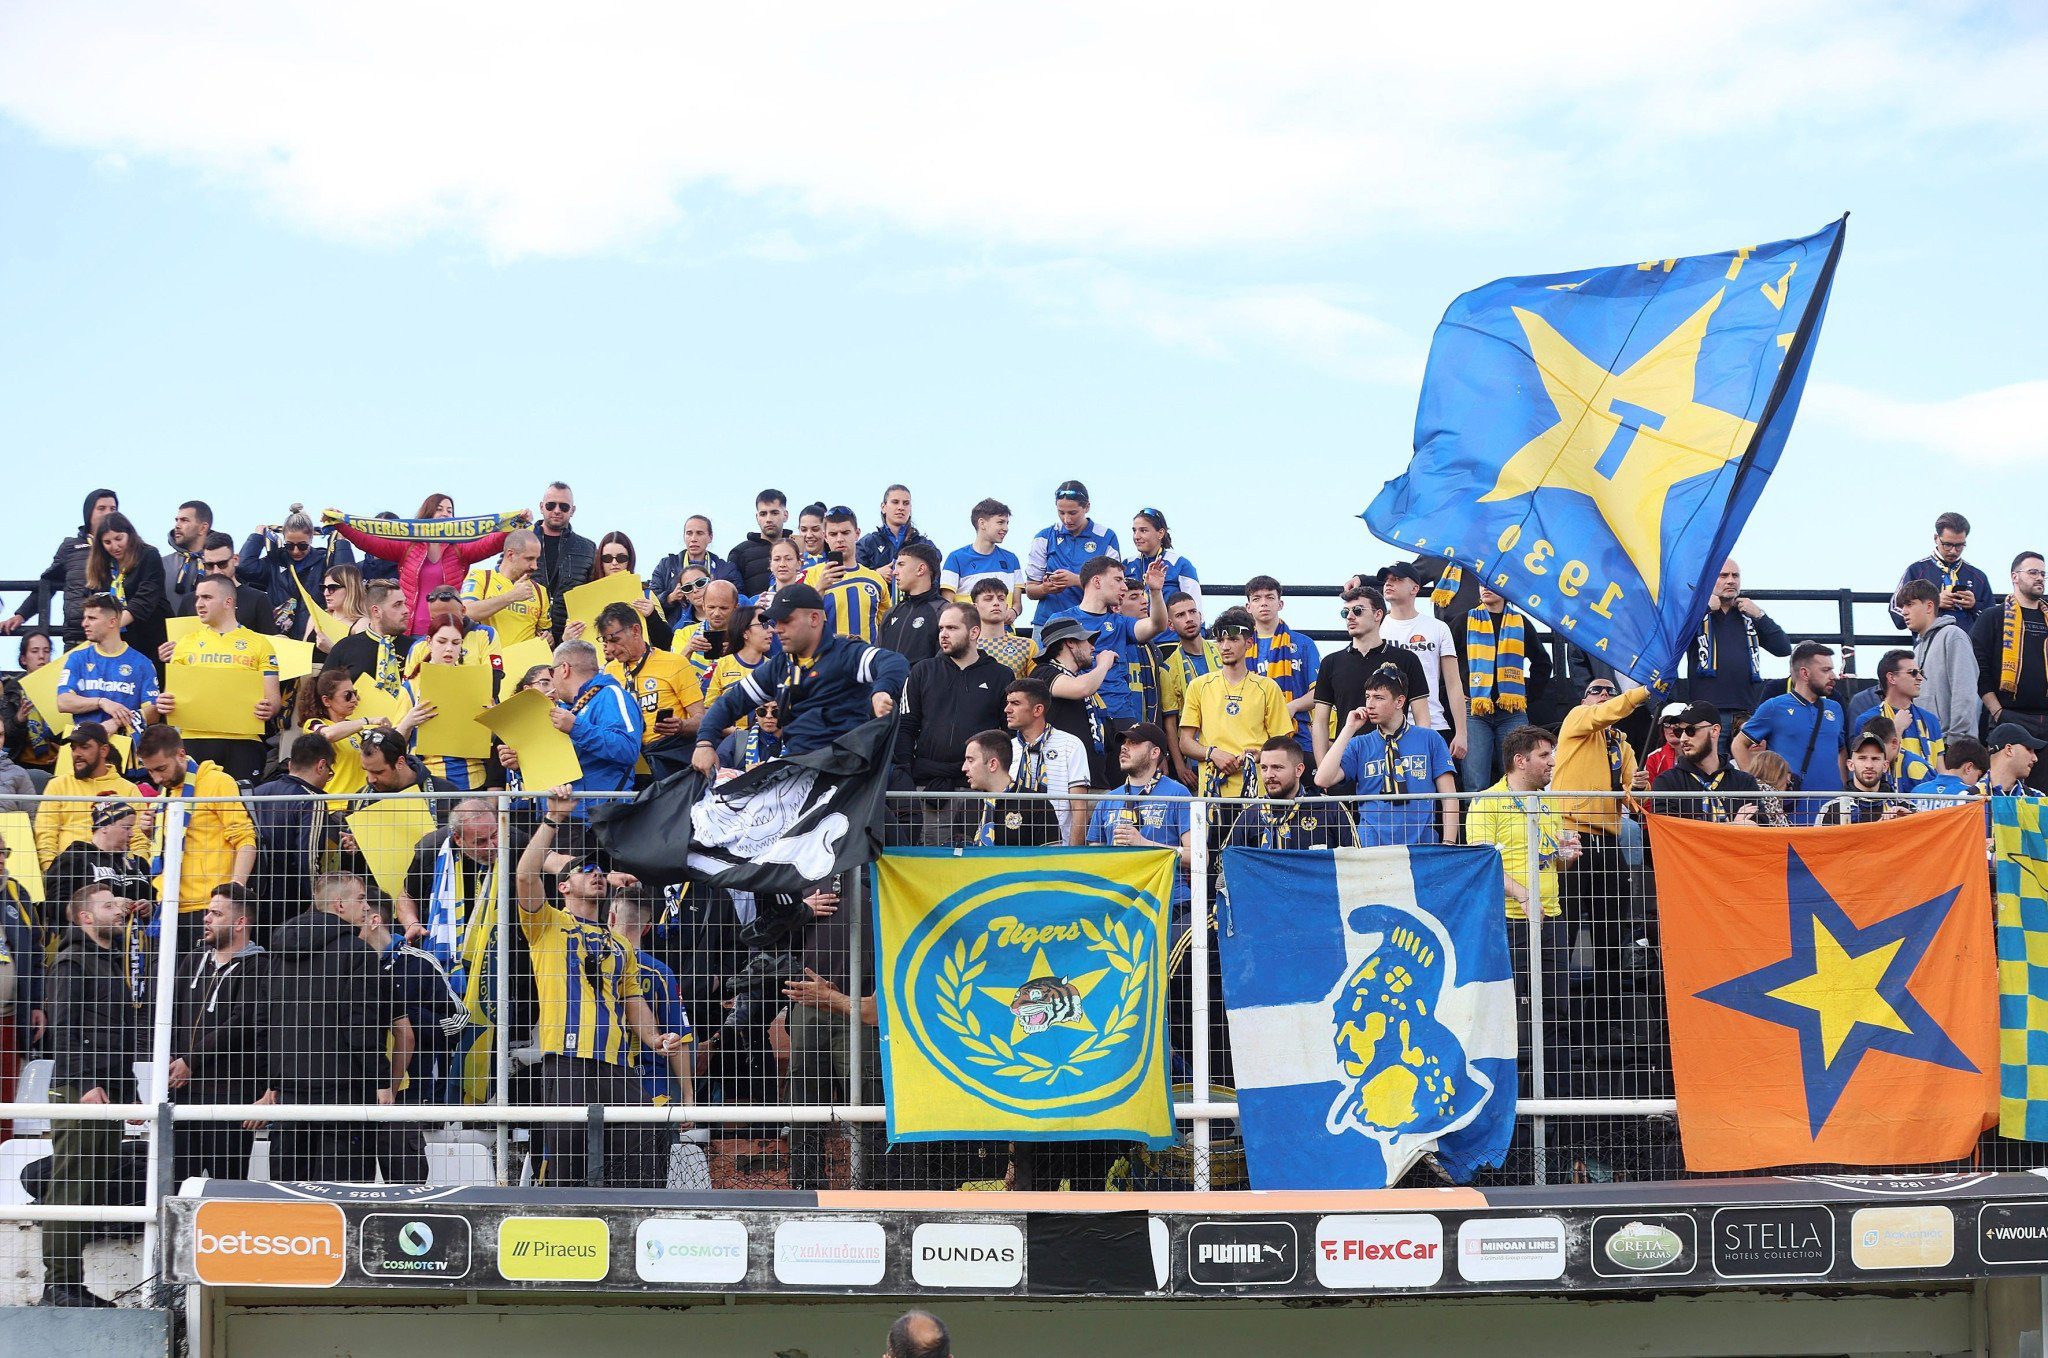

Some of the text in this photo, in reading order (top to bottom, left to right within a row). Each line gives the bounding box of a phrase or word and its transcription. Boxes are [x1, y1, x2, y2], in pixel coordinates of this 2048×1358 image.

[350, 520, 409, 536] ASTERAS
[413, 519, 476, 537] TRIPOLIS
[84, 679, 136, 696] intrakat
[988, 915, 1081, 953] Tigers
[1725, 1223, 1822, 1250] STELLA
[1995, 1226, 2048, 1240] VAVOULA
[197, 1229, 331, 1255] betsson
[533, 1241, 597, 1257] Piraeus
[1343, 1239, 1438, 1260] FlexCar
[1482, 1240, 1556, 1251] MINOAN LINES
[669, 1245, 741, 1258] COSMOTE
[922, 1247, 1015, 1262] DUNDAS
[1198, 1244, 1261, 1263] PUMA
[1637, 1251, 1672, 1259] FARMS
[1725, 1251, 1823, 1260] HOTELS COLLECTION
